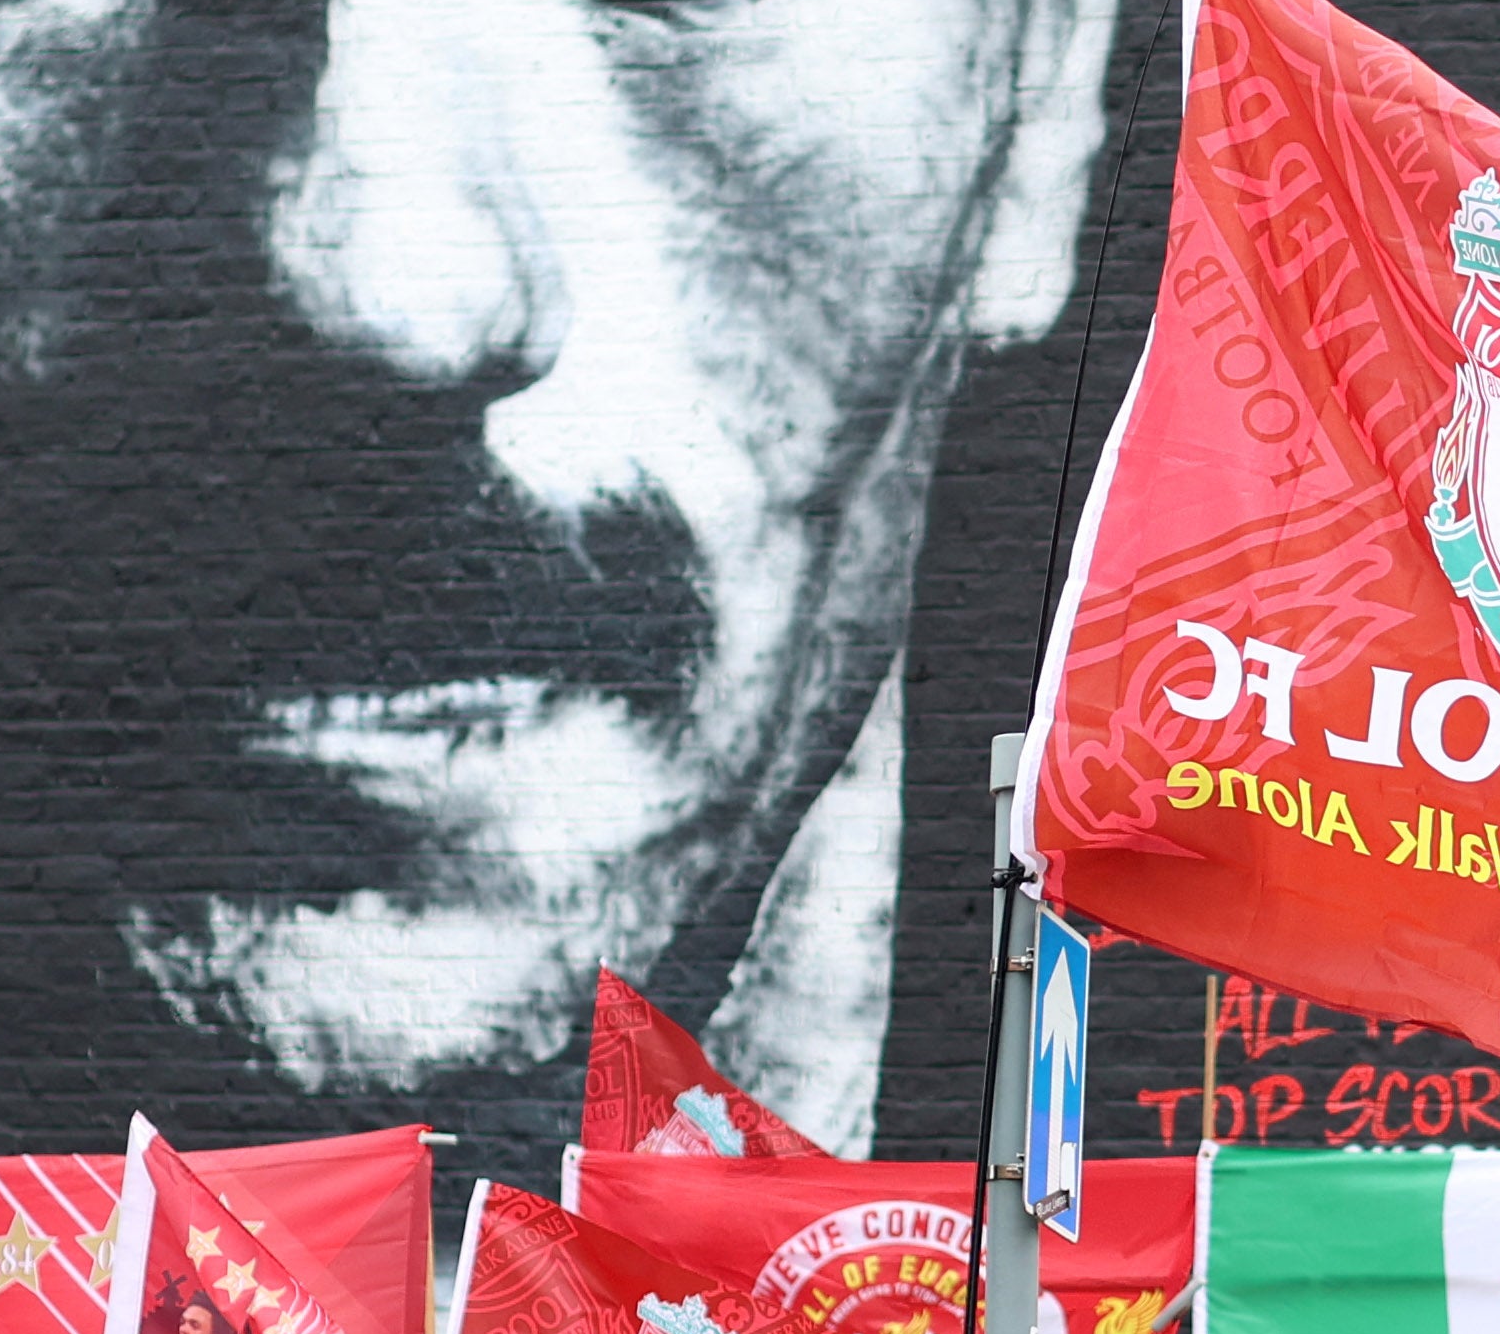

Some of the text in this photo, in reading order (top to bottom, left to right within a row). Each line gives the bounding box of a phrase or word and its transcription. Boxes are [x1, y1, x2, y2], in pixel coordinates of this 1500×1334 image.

[1215, 975, 1336, 1059] ALL
[1136, 1073, 1306, 1149] TOP
[0, 1241, 36, 1276] 84
[843, 1254, 881, 1290] OF
